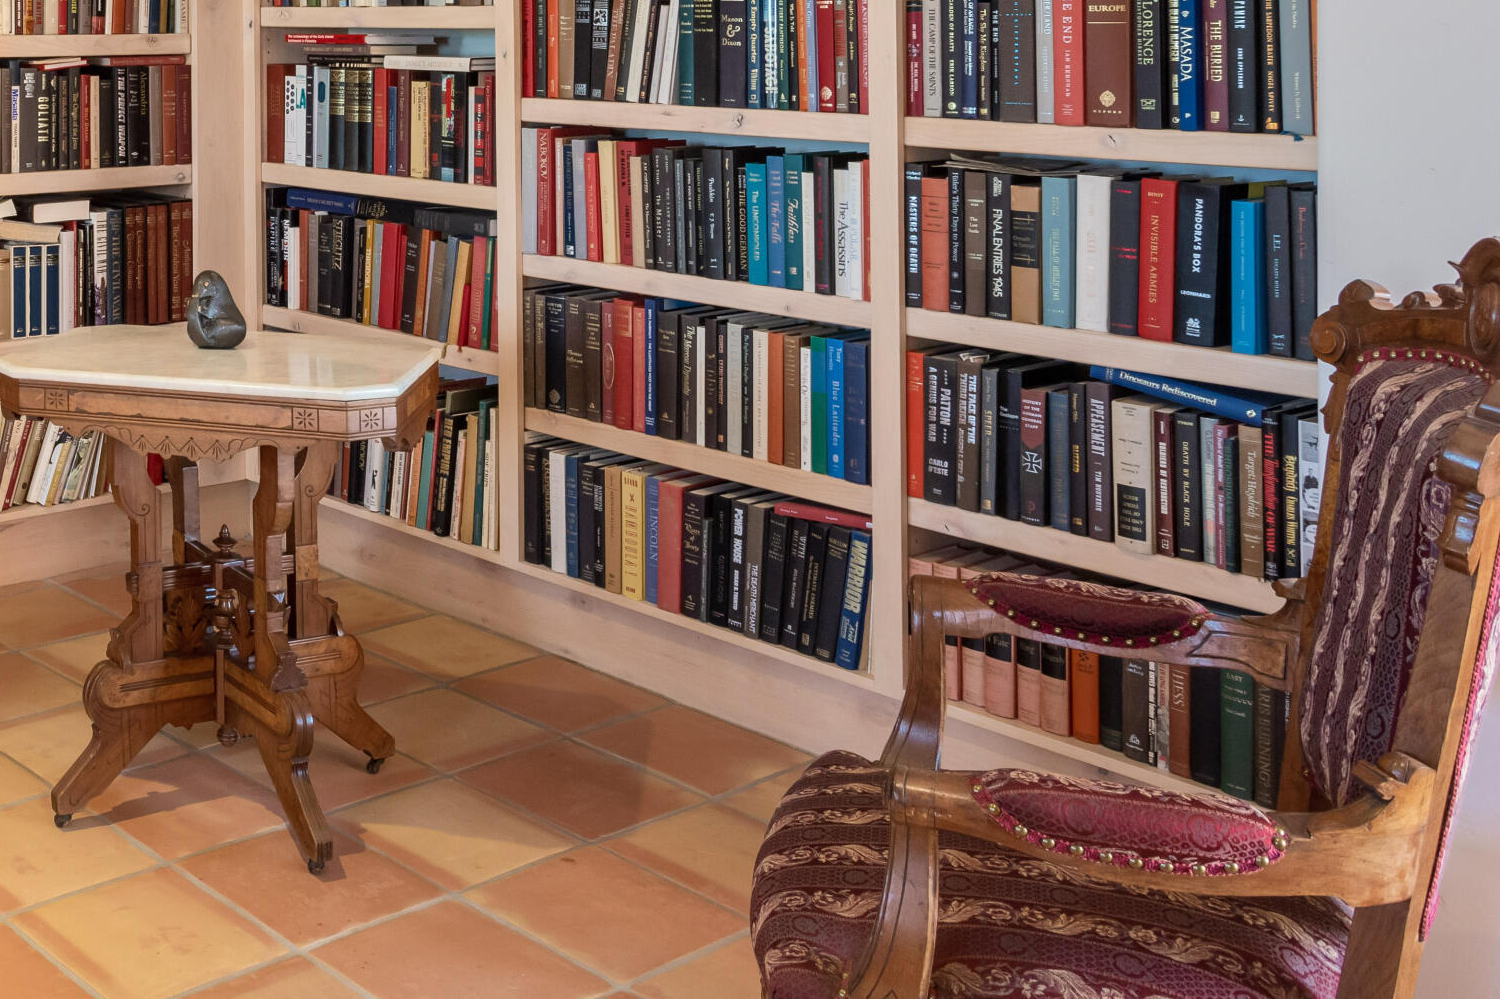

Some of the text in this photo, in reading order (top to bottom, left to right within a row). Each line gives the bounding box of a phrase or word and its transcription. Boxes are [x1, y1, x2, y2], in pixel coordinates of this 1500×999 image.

[1062, 16, 1072, 44] END
[1089, 4, 1126, 13] EUROPE
[1233, 0, 1246, 29] FAMINE
[928, 9, 936, 96] THE CAMP OF THE SAINTS
[1180, 26, 1193, 81] MASADA
[1209, 20, 1222, 82] THE BURIED
[11, 89, 19, 121] Masada
[38, 96, 49, 142] GOLIATH
[539, 133, 548, 179] NABOKOV
[739, 190, 747, 270] THE GOOD GERMAN
[788, 198, 799, 243] Faithless
[837, 201, 849, 277] The Assassins
[1192, 198, 1203, 273] PANDORA'S BOX
[992, 209, 1003, 297] FINAL ENTRIES 1945
[1149, 214, 1159, 304] INVISIBLE ARMIES
[832, 380, 840, 446] Blue Latitudes
[928, 375, 937, 403] GENIUS
[928, 405, 937, 421] FOR
[940, 388, 951, 425] PATTON
[1118, 370, 1217, 406] Dinosaurs Rediscovered
[928, 423, 937, 442] WAR
[1090, 398, 1105, 456] APPEASEMENT
[1182, 441, 1190, 526] DEATH BY BLACK HOLE
[732, 508, 743, 564] POWER HOUSE
[844, 540, 868, 614] WARRIOR
